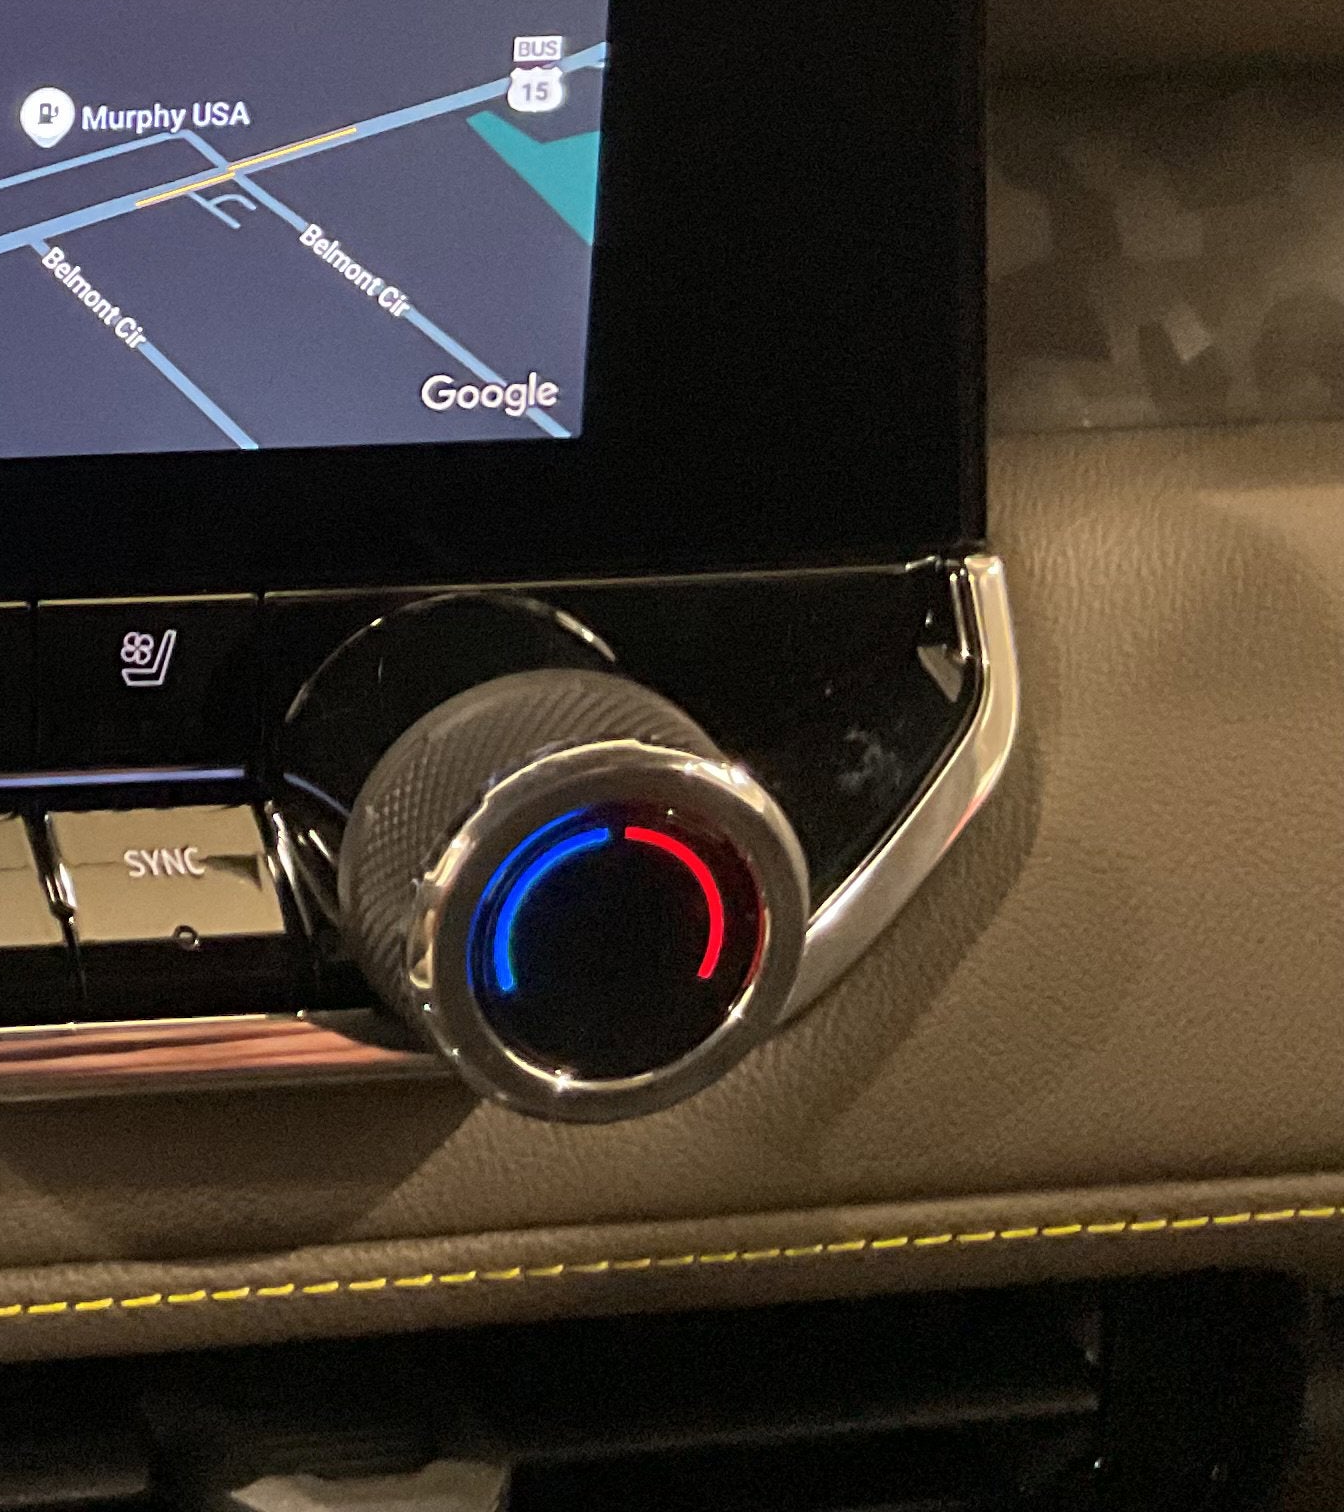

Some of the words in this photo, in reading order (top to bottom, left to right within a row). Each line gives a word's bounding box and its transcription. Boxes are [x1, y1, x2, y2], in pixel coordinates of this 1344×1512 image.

[517, 39, 559, 57] BUS
[522, 82, 548, 102] 15
[81, 105, 187, 133] Murphy
[192, 101, 250, 127] USA
[299, 223, 381, 295] Belmont
[376, 282, 410, 318] Cir
[42, 246, 119, 325] Belmont
[113, 315, 147, 350] Cir
[421, 372, 560, 417] Google
[123, 847, 205, 879] SYNC
